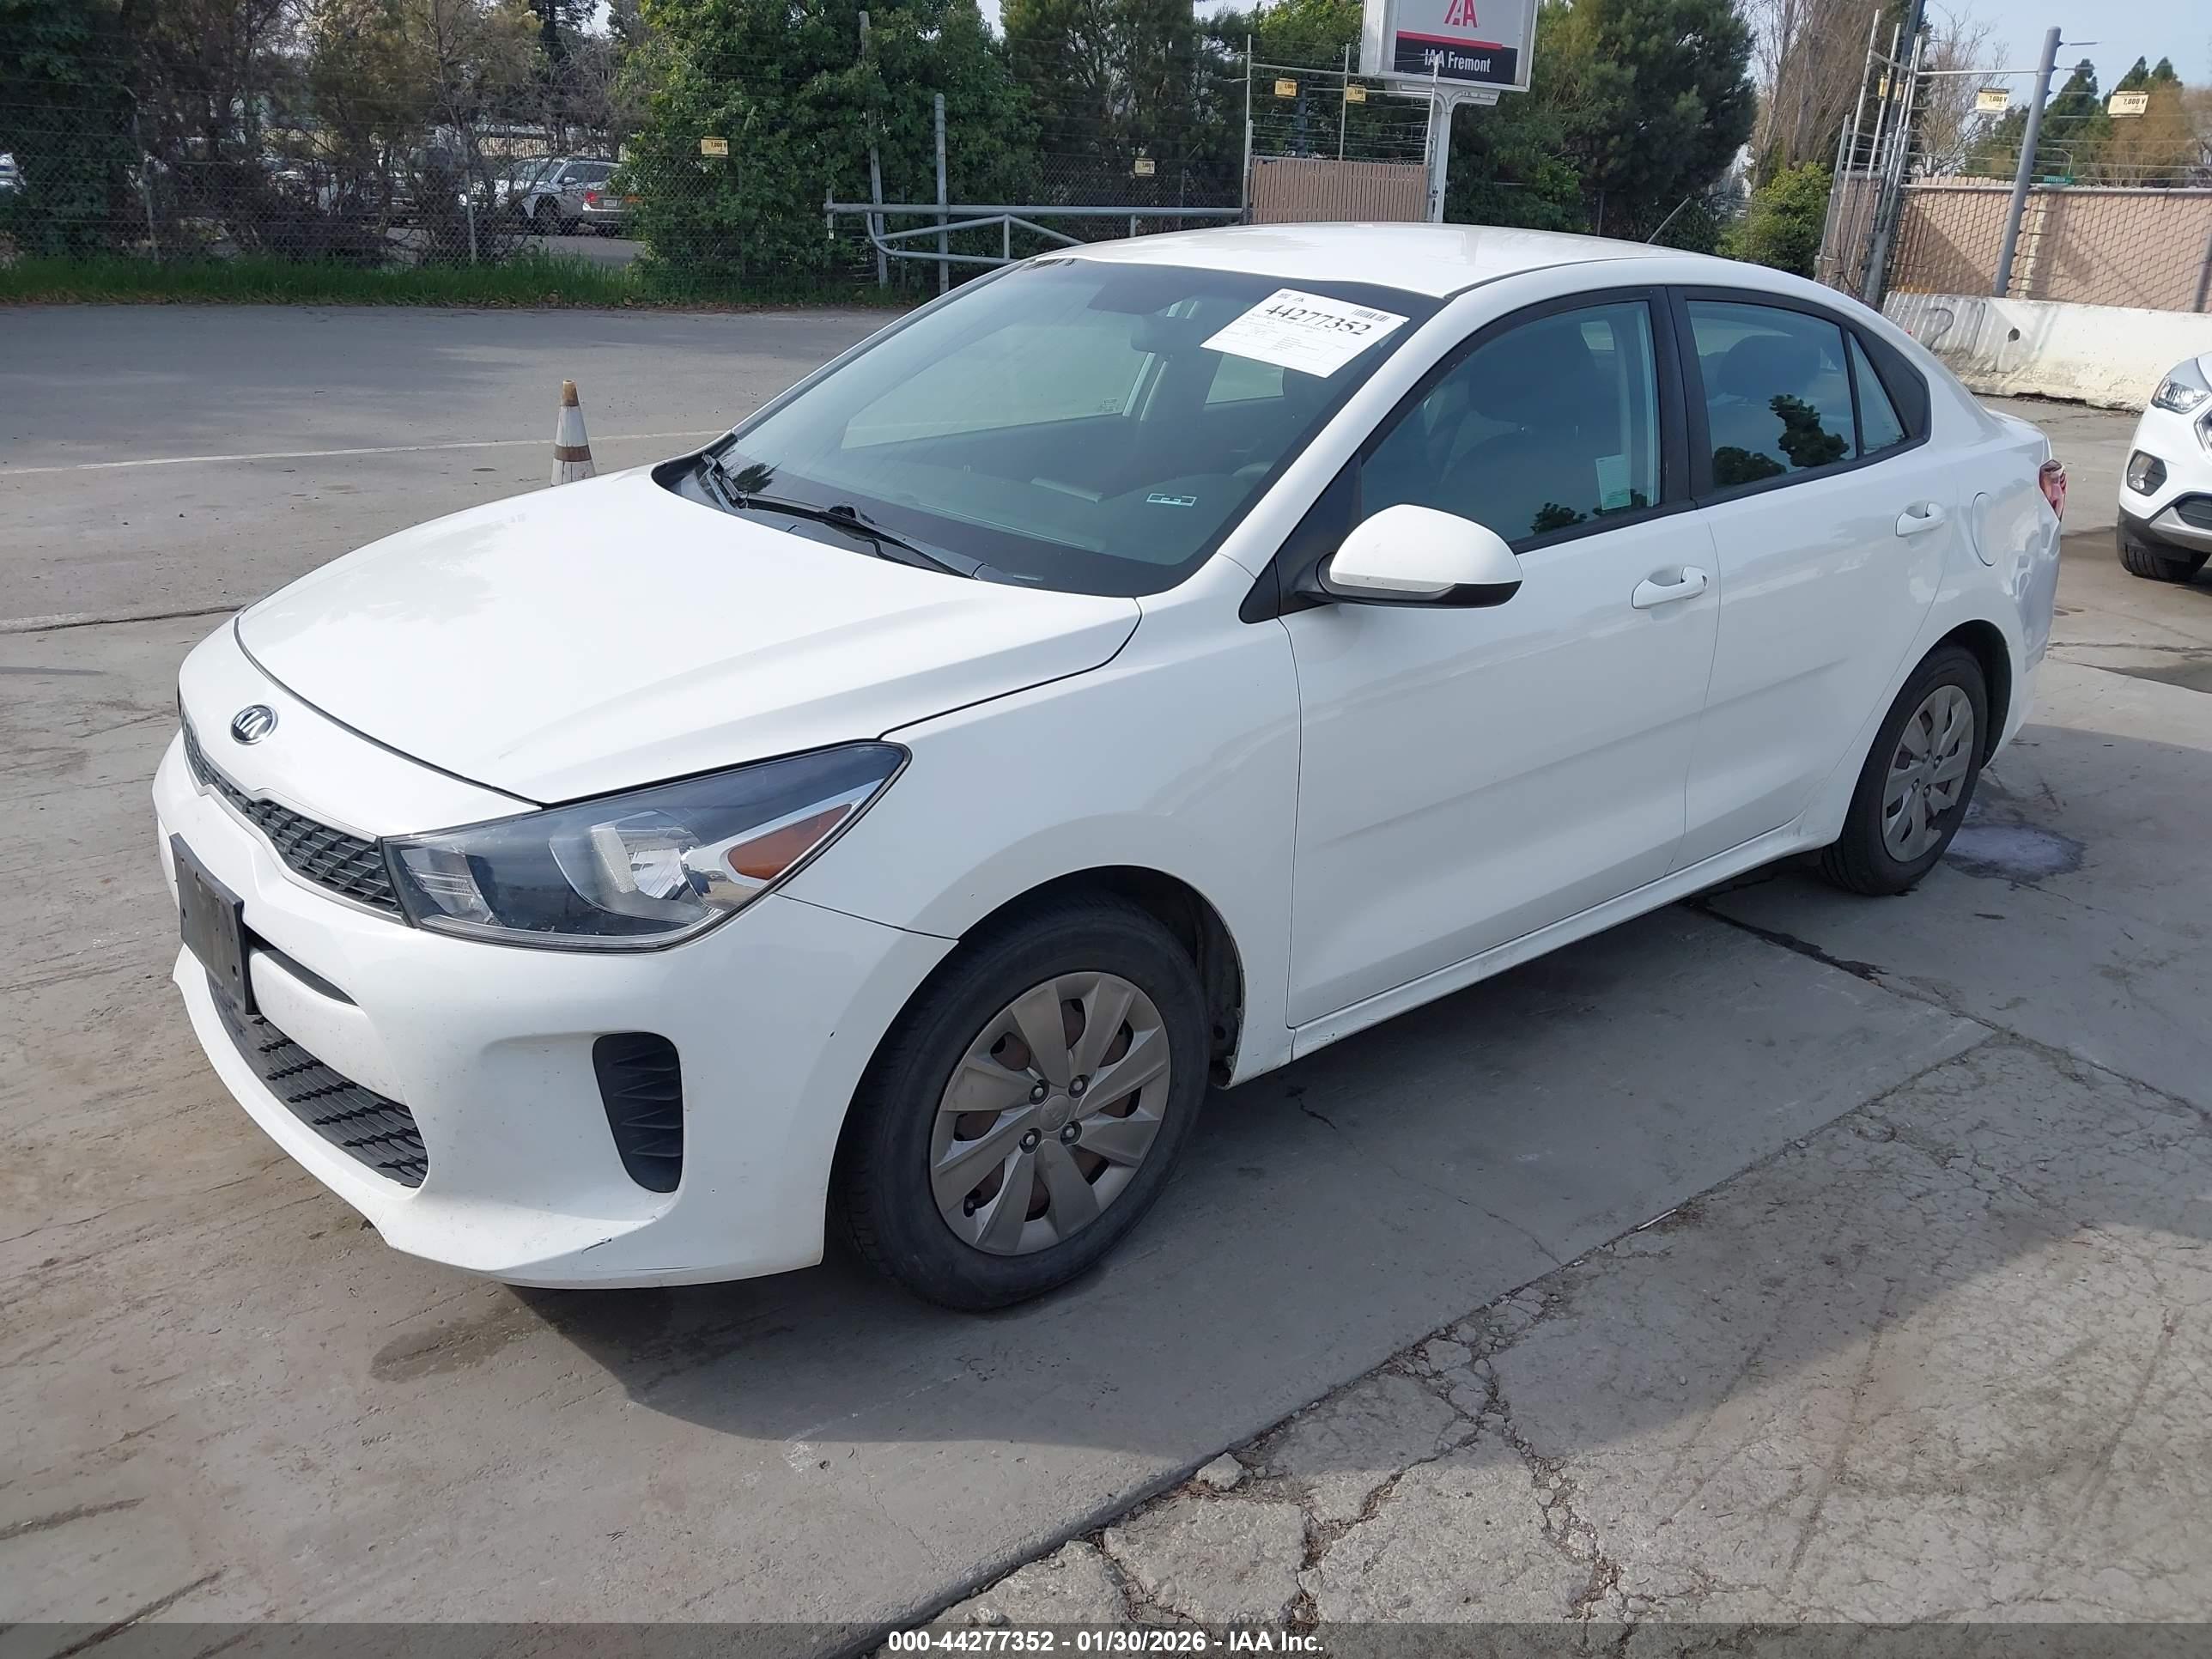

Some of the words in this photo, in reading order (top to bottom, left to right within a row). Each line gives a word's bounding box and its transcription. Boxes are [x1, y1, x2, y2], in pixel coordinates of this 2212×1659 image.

[1425, 48, 1445, 68] IAA
[1448, 51, 1492, 73] Fremont
[1265, 304, 1371, 335] 44277352
